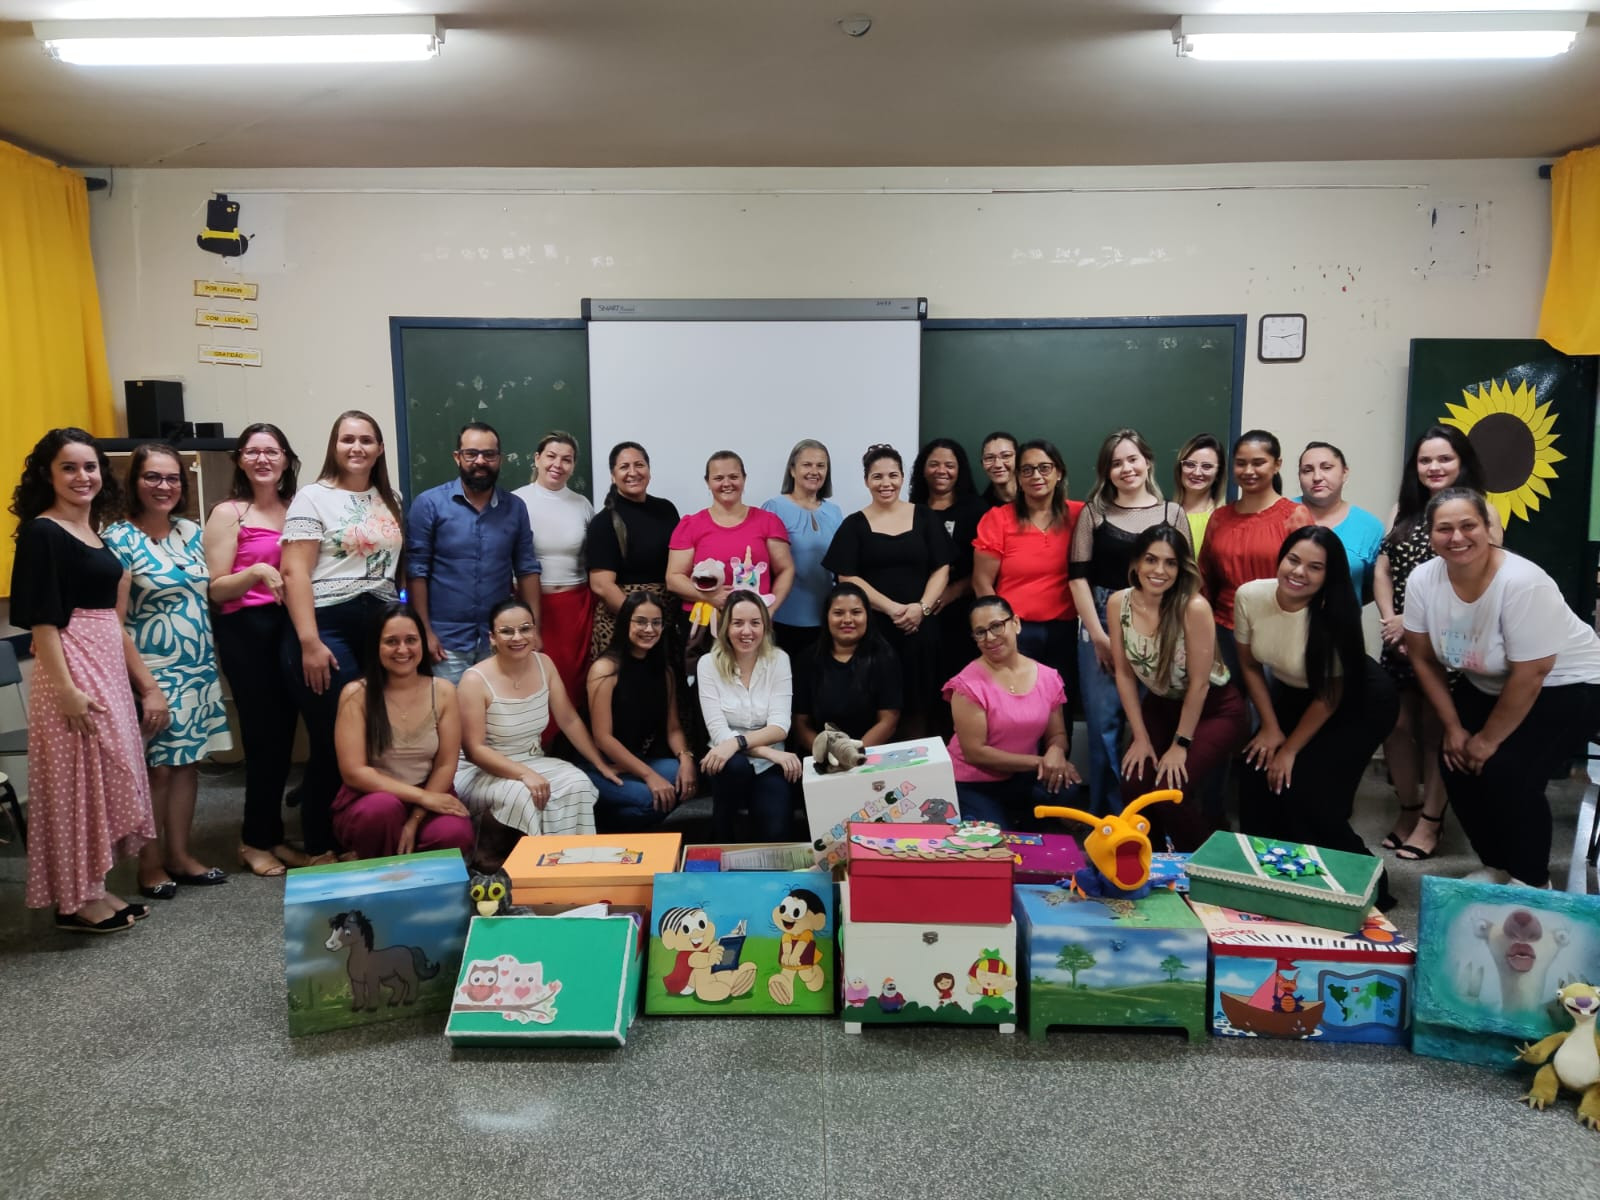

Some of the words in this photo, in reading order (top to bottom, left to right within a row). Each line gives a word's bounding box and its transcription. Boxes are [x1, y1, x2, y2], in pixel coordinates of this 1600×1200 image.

[222, 286, 243, 294] FAVOR
[224, 316, 249, 324] LICENÇA
[814, 780, 917, 852] CONIÊNCIA
